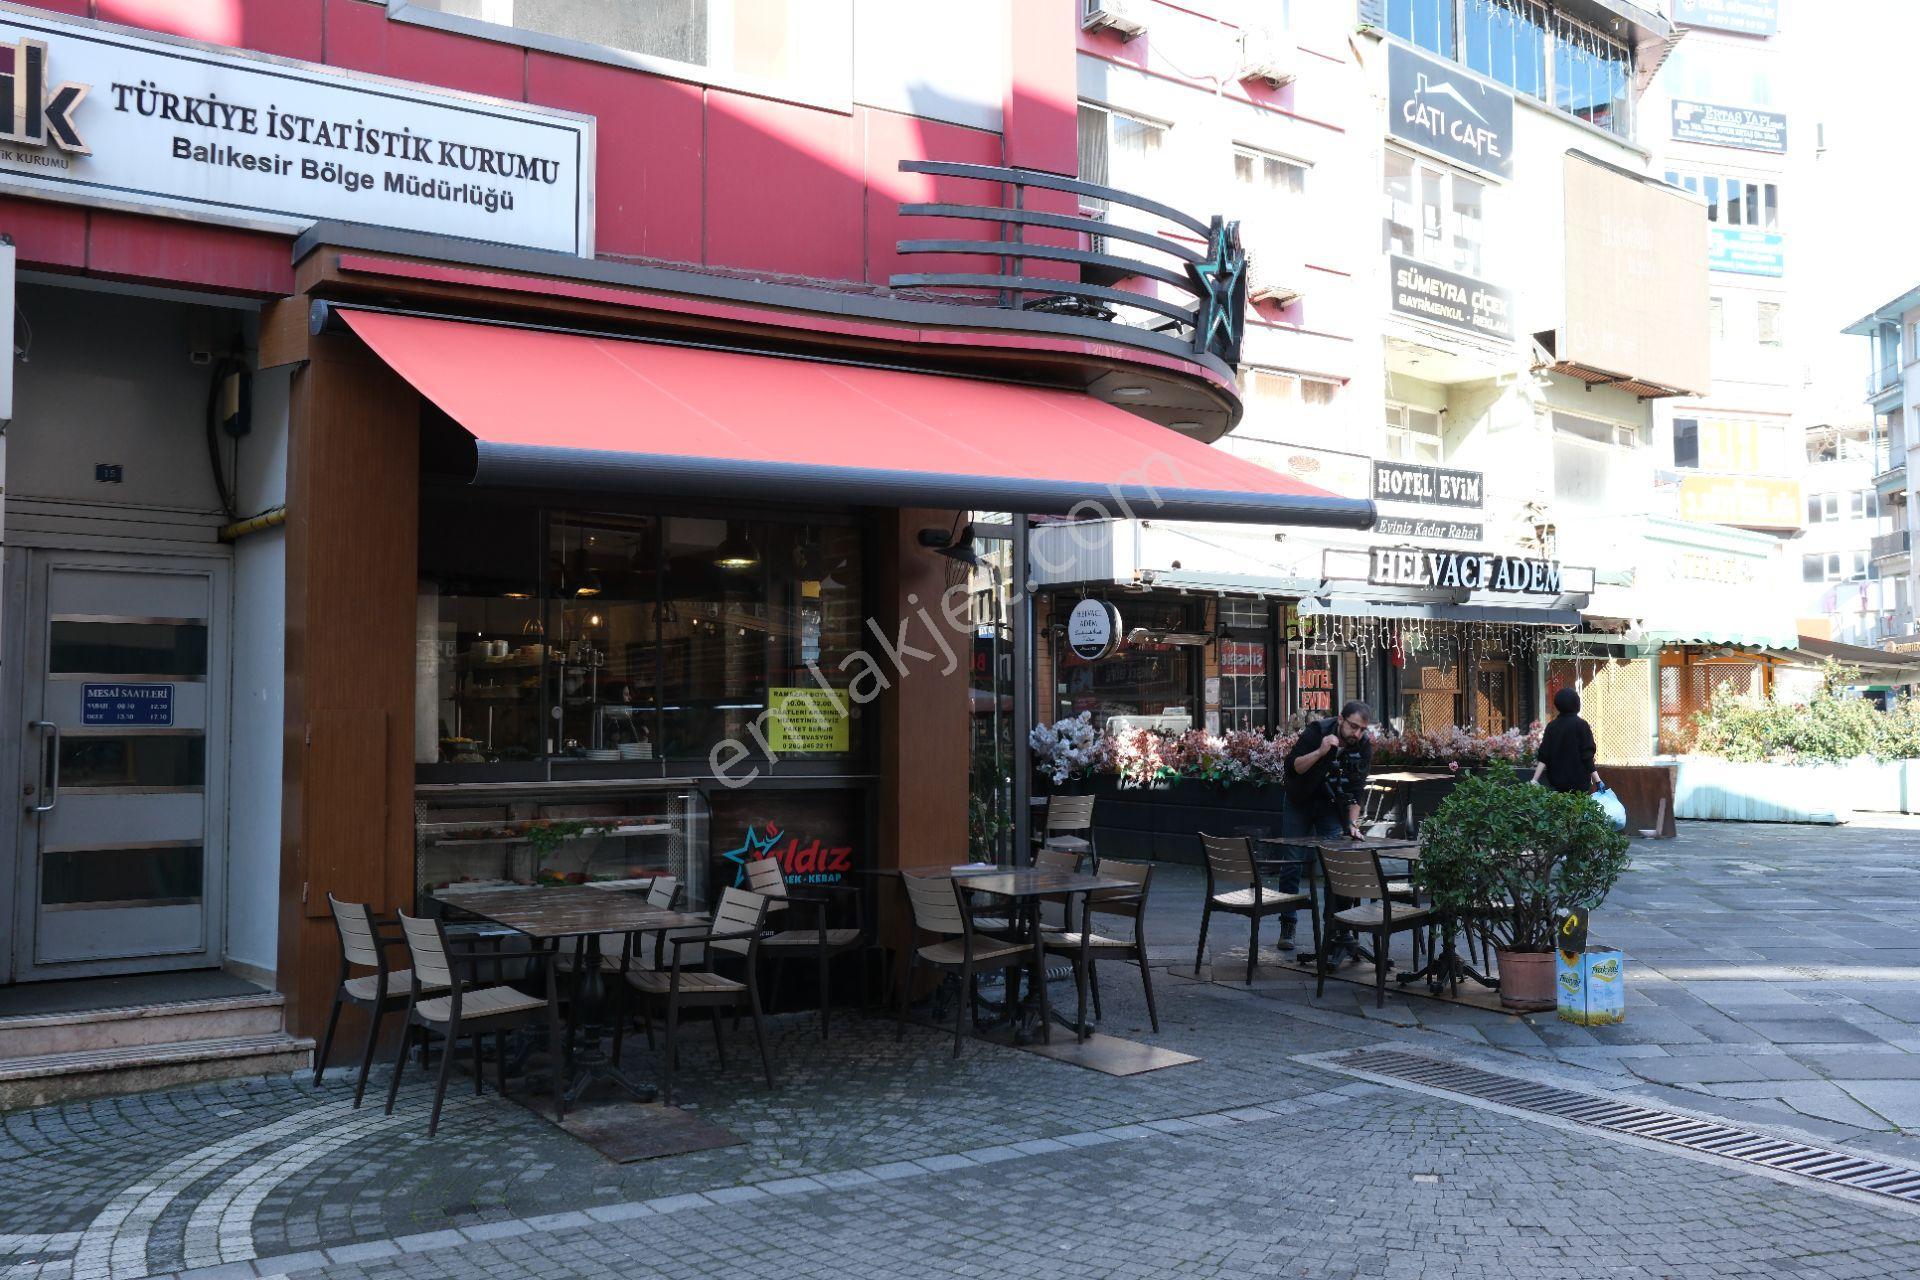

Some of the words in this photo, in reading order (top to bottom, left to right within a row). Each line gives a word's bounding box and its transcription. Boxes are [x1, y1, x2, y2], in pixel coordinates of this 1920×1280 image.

[111, 80, 258, 135] TÜRKİYE
[266, 104, 432, 164] İSTATİSTİK
[438, 141, 560, 184] KURUMU
[1450, 119, 1501, 158] CAFE
[16, 152, 70, 170] KURUMU
[172, 136, 293, 176] Balıkesir
[301, 158, 375, 192] Bölge
[384, 171, 514, 213] Müdürlüğü
[1397, 266, 1467, 305] SÜMEYRA
[1399, 293, 1465, 322] GAYRİMENKUL
[1378, 468, 1433, 498] HOTEL
[1379, 519, 1412, 536] Eviniz
[1414, 521, 1447, 539] Kadar
[1449, 524, 1479, 541] Rahat
[1495, 554, 1564, 593] ADEM
[87, 687, 119, 698] MESAİ
[121, 688, 168, 699] SAATLERİ
[1299, 669, 1334, 690] HOTEL
[808, 873, 842, 884] KEBAP
